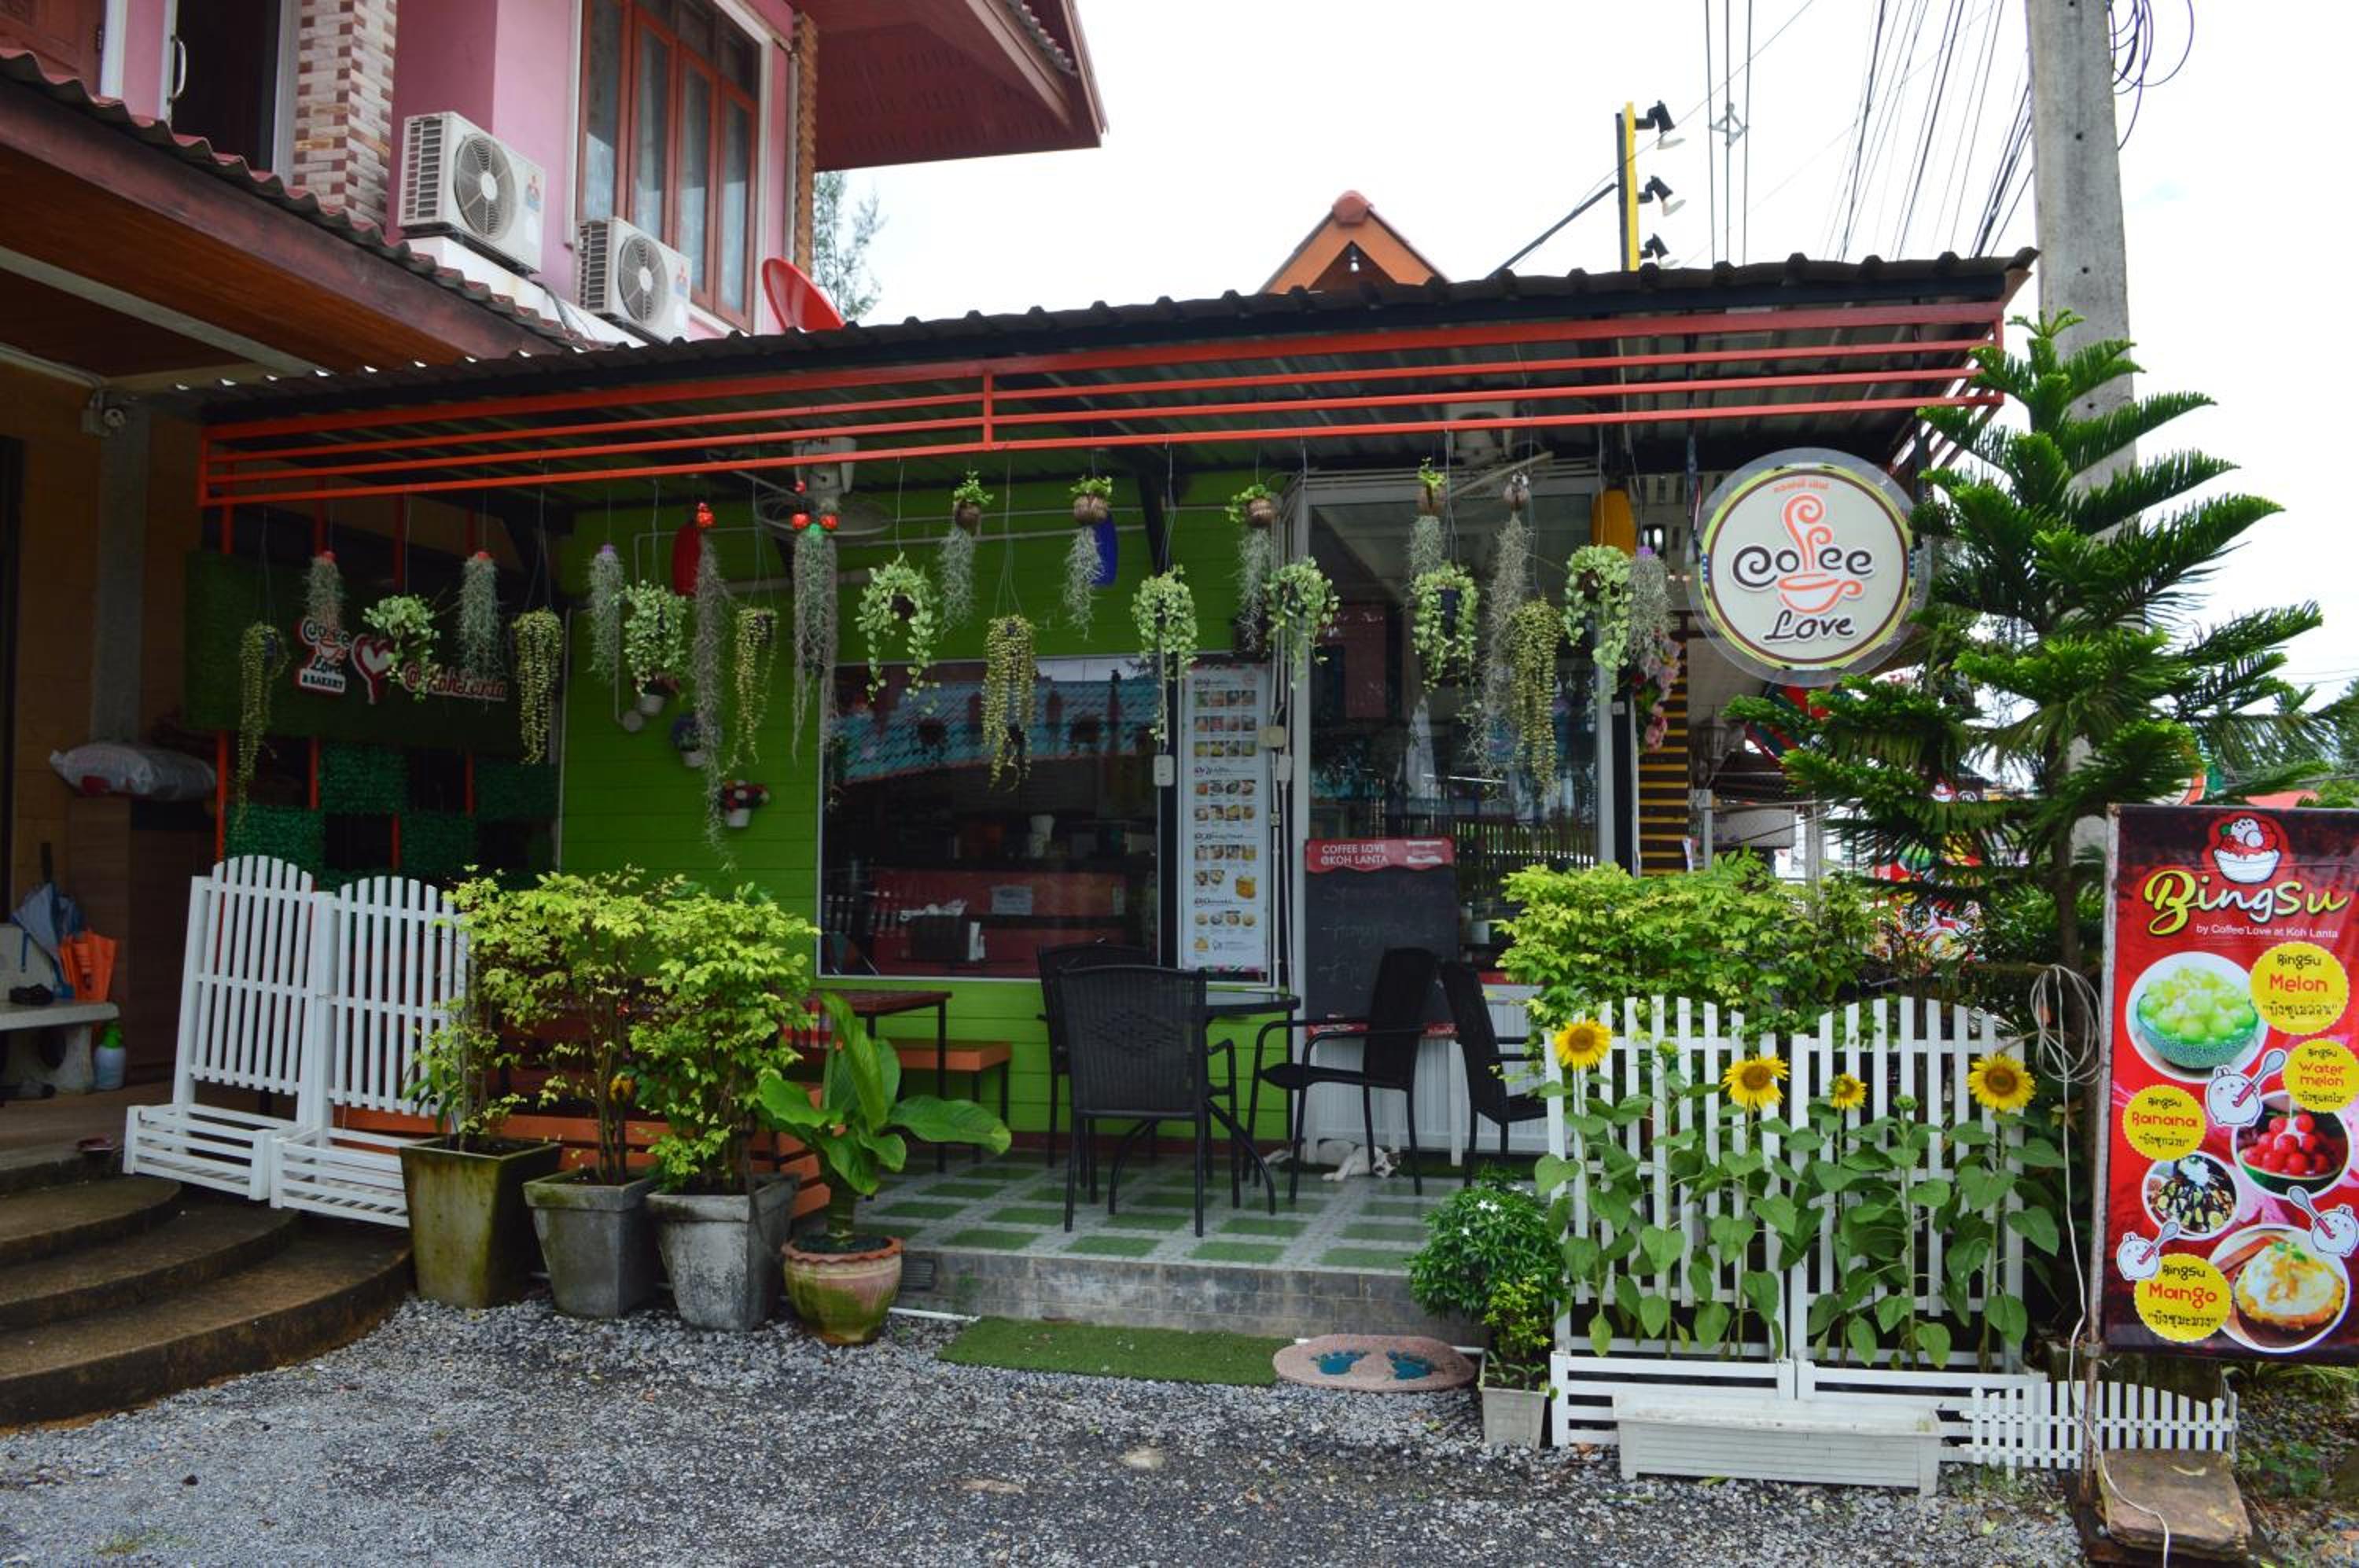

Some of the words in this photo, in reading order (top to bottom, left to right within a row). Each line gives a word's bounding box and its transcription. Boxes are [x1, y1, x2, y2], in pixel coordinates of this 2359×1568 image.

[1764, 609, 1854, 640] Love
[1322, 844, 1358, 855] COFFEE
[1361, 843, 1385, 853] LOVE
[1320, 855, 1352, 865] @KOH
[1355, 855, 1390, 865] LANTA
[2196, 923, 2209, 935] by
[2286, 926, 2307, 937] Koh
[2309, 927, 2339, 938] Lanta
[2269, 974, 2328, 993] Melon
[2298, 1062, 2346, 1076] Water
[2300, 1075, 2344, 1088] melon
[2132, 1111, 2199, 1128] Banana
[2149, 1283, 2217, 1309] Mango
